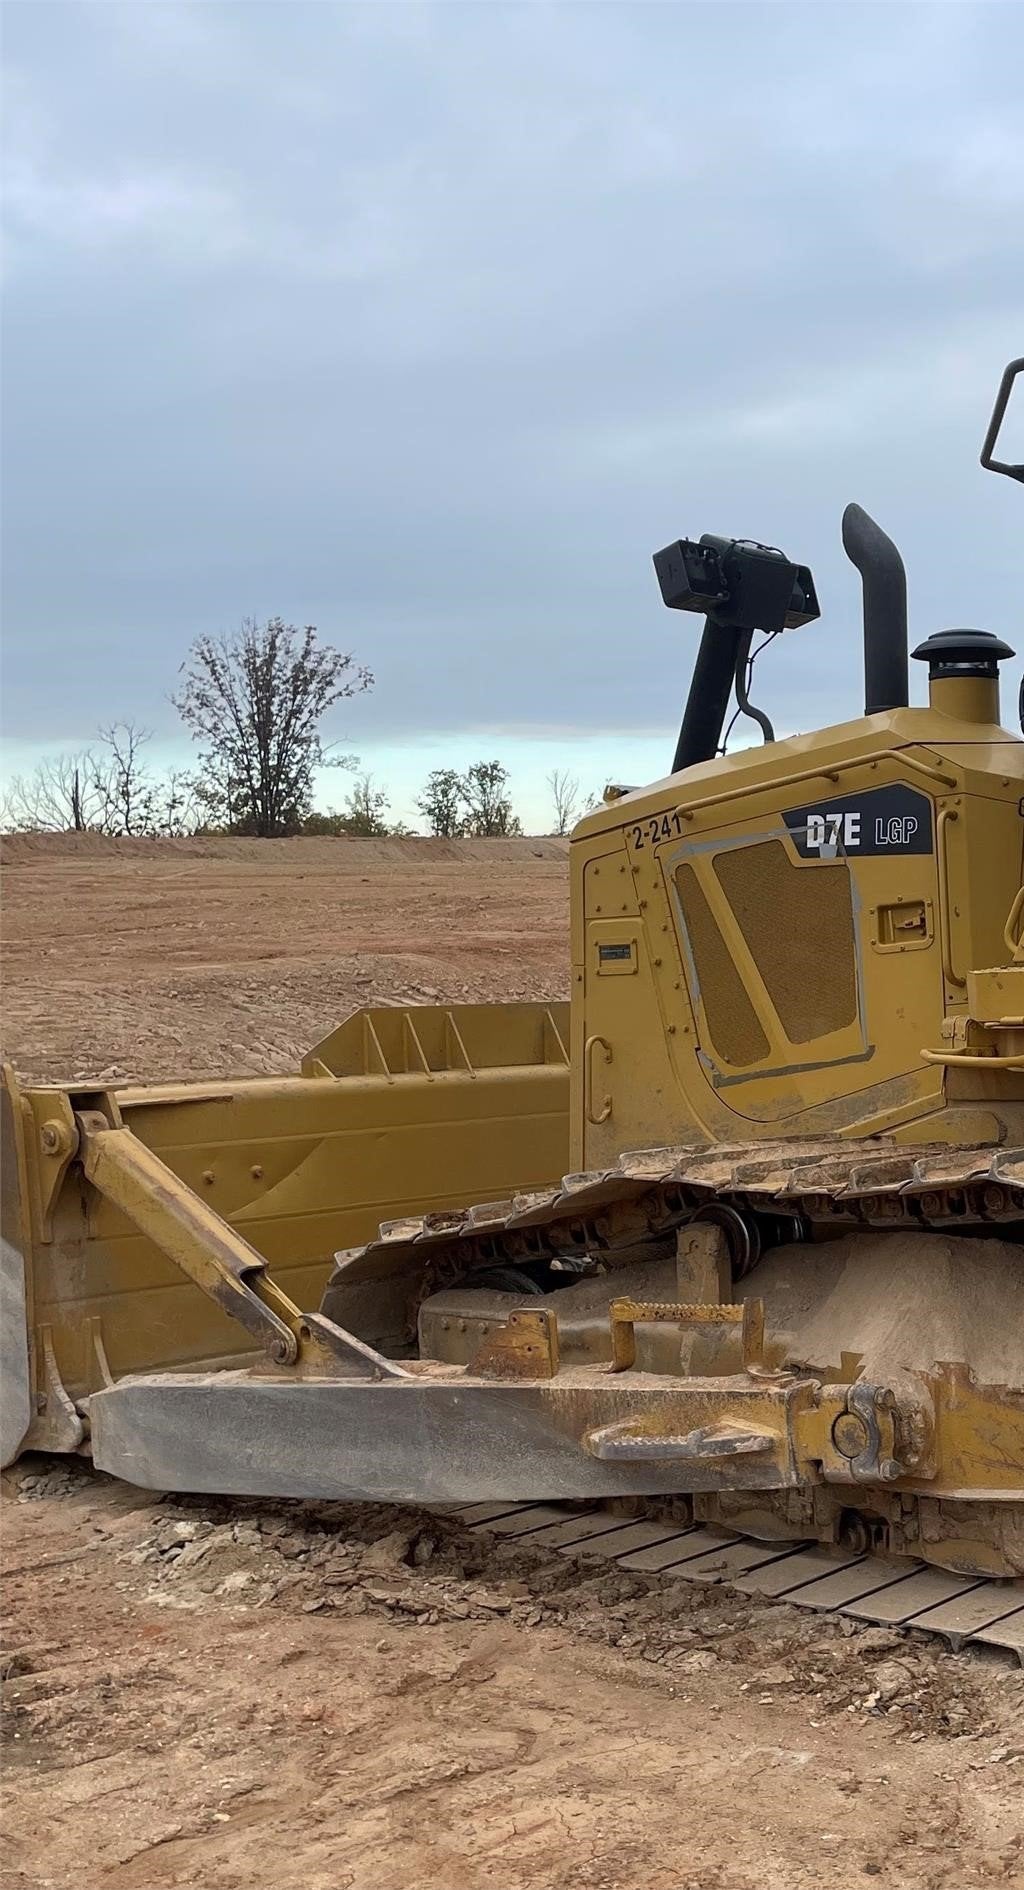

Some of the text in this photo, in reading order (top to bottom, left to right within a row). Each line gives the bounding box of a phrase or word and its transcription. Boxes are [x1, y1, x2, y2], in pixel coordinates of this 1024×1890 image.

[632, 812, 681, 849] 2-241
[806, 812, 918, 848] D7E LGP
